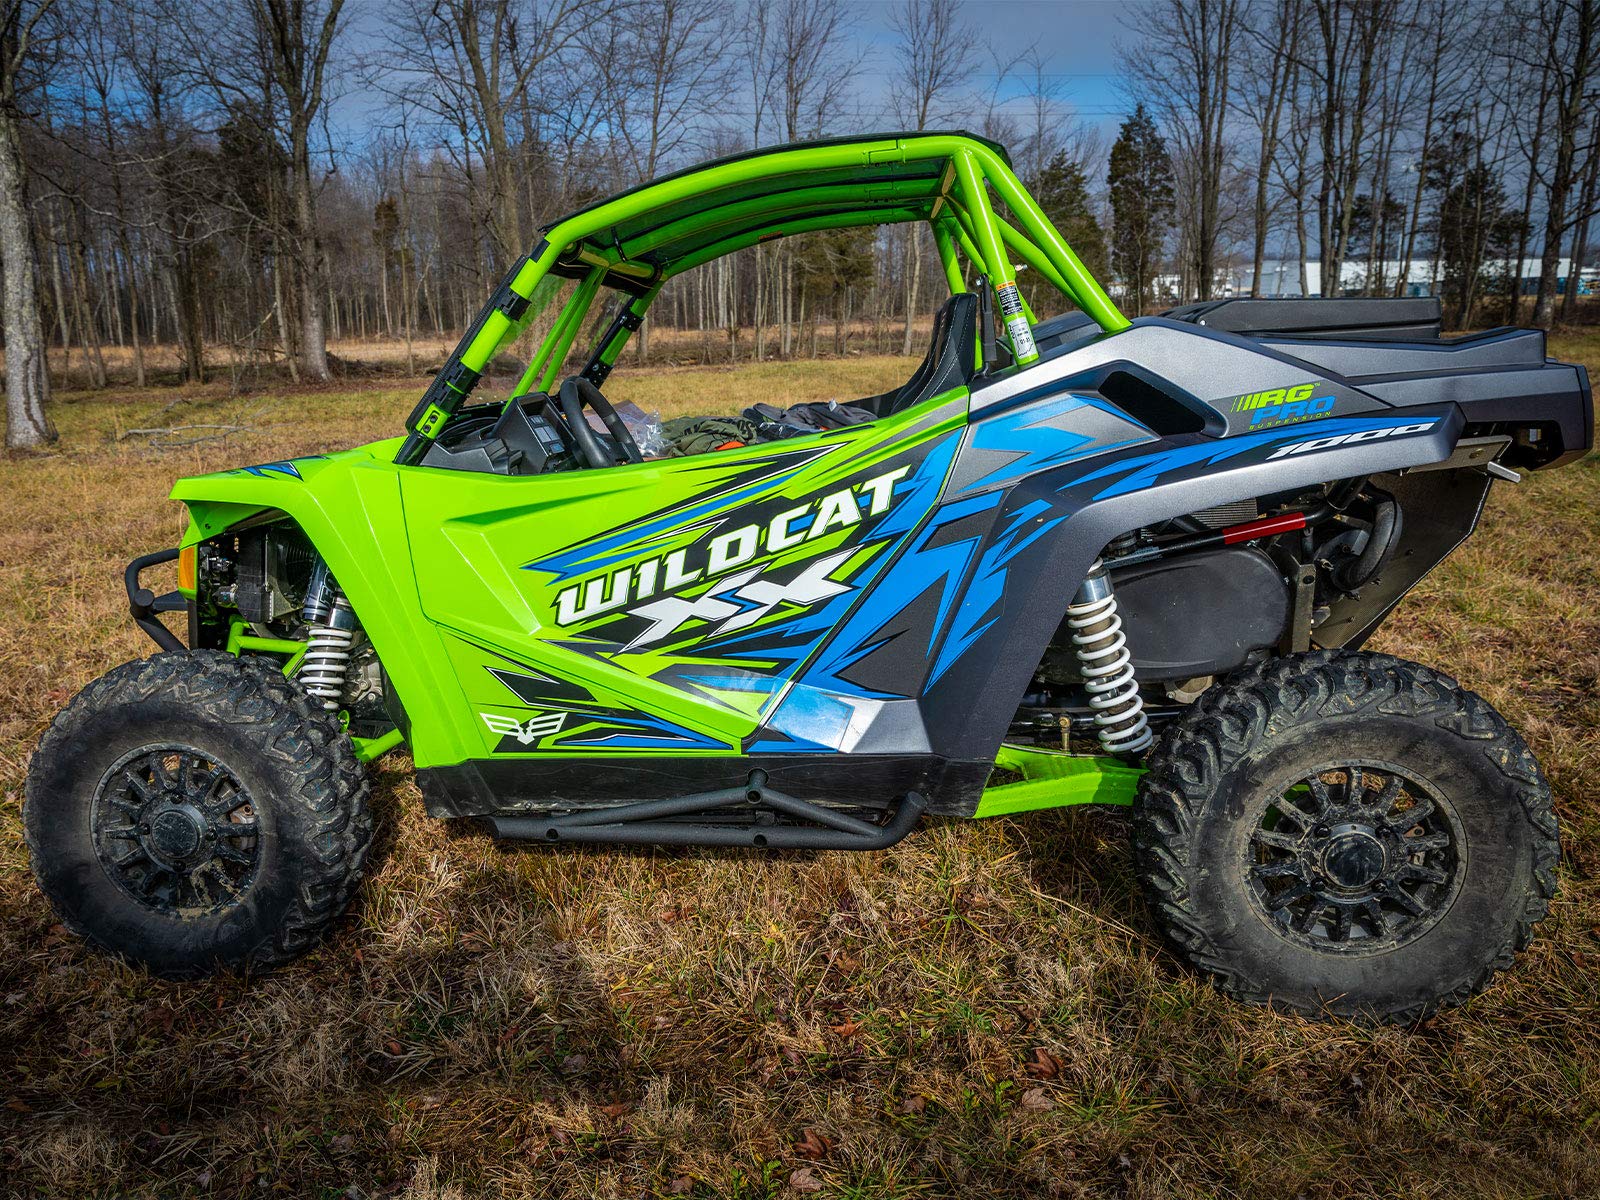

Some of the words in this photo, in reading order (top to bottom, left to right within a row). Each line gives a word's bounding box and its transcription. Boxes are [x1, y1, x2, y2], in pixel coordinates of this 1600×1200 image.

[1248, 411, 1331, 431] SUSPENSION
[1250, 395, 1336, 425] PRO
[1266, 422, 1435, 460] 1000
[555, 464, 912, 626] WILDCAT
[618, 545, 864, 653] XX
